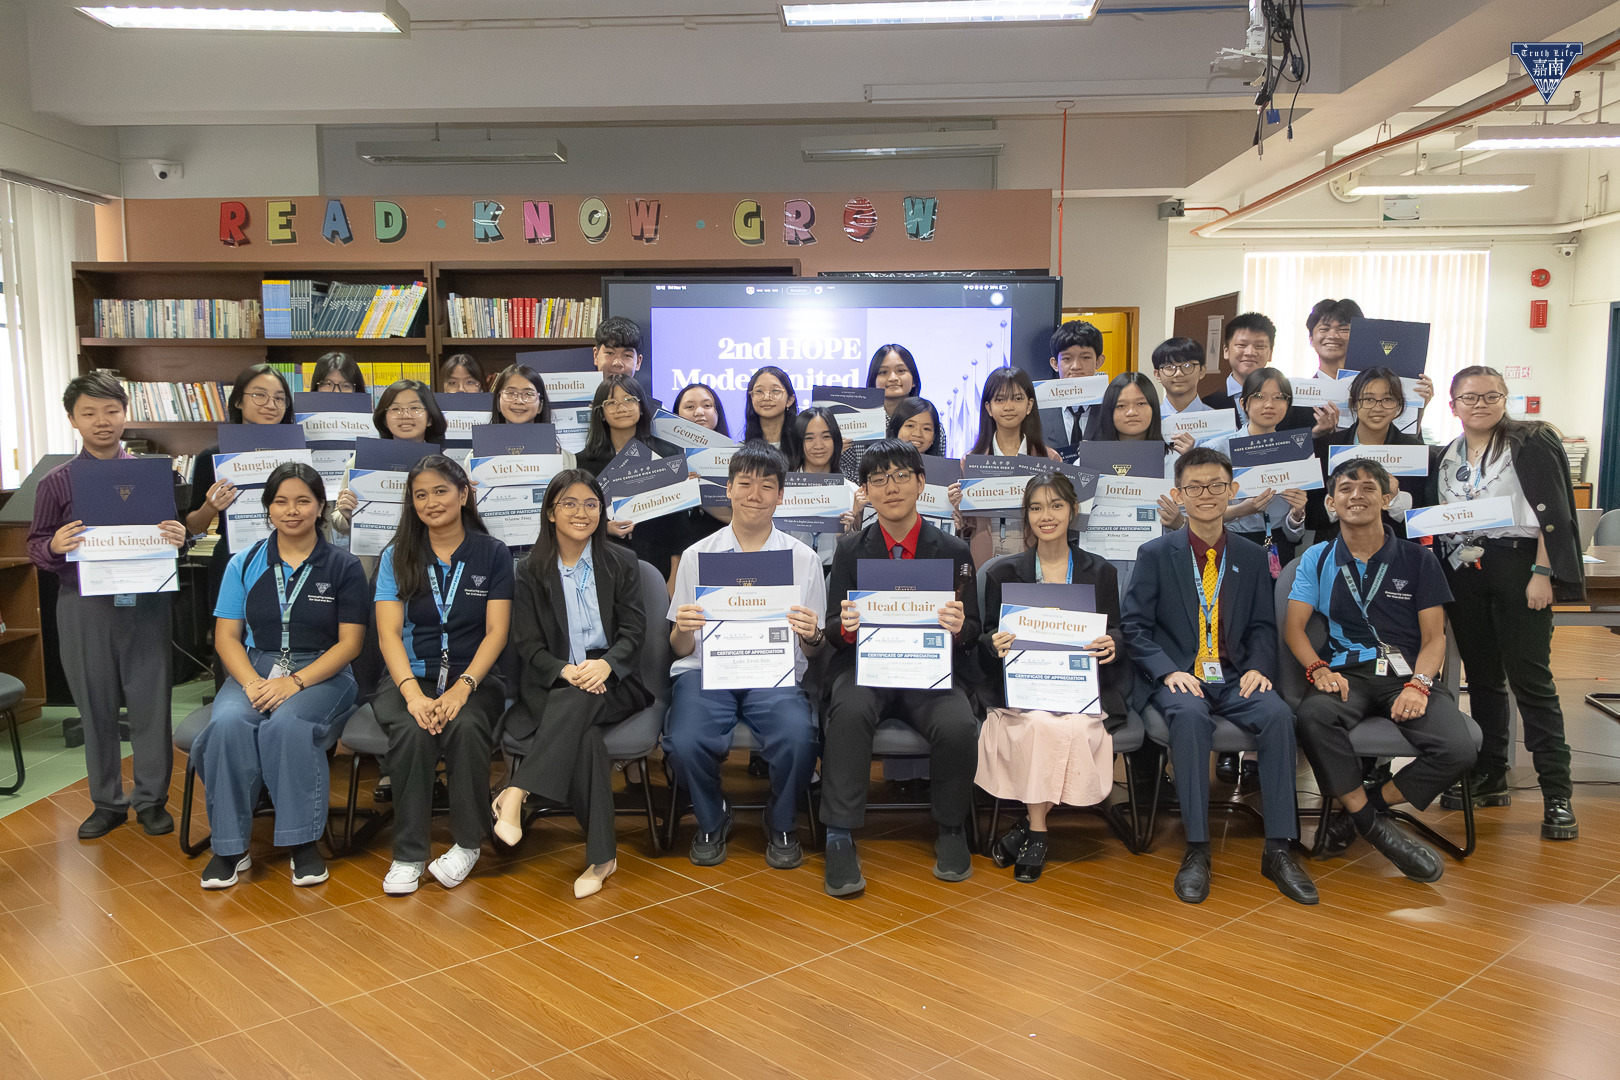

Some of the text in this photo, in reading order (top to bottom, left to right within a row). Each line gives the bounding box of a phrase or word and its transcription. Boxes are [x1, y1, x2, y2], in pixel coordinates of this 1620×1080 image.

[219, 196, 939, 247] READ KNOW GROW
[718, 337, 861, 361] 2nd HOPE
[786, 368, 860, 391] nited
[1506, 370, 1520, 378] EXIT
[544, 380, 585, 390] ambodia
[1294, 386, 1322, 396] India
[1048, 385, 1083, 398] Algeria
[306, 420, 370, 430] United States
[839, 420, 868, 430] entina
[1173, 419, 1208, 432] Angola
[673, 425, 709, 446] Georgia
[714, 456, 732, 465] Ben
[492, 464, 540, 474] Viet Nam
[1260, 472, 1290, 484] Egypt
[380, 479, 408, 490] Chin
[1106, 484, 1142, 496] Jordan
[967, 486, 1026, 498] Guinea-Bis
[631, 492, 681, 513] Zimbabwe
[1442, 510, 1474, 522] Syria
[83, 535, 172, 547] nited Kingdom
[728, 596, 766, 606] Ghana
[868, 602, 935, 612] Head Chair
[1018, 615, 1087, 632] Rapporteur
